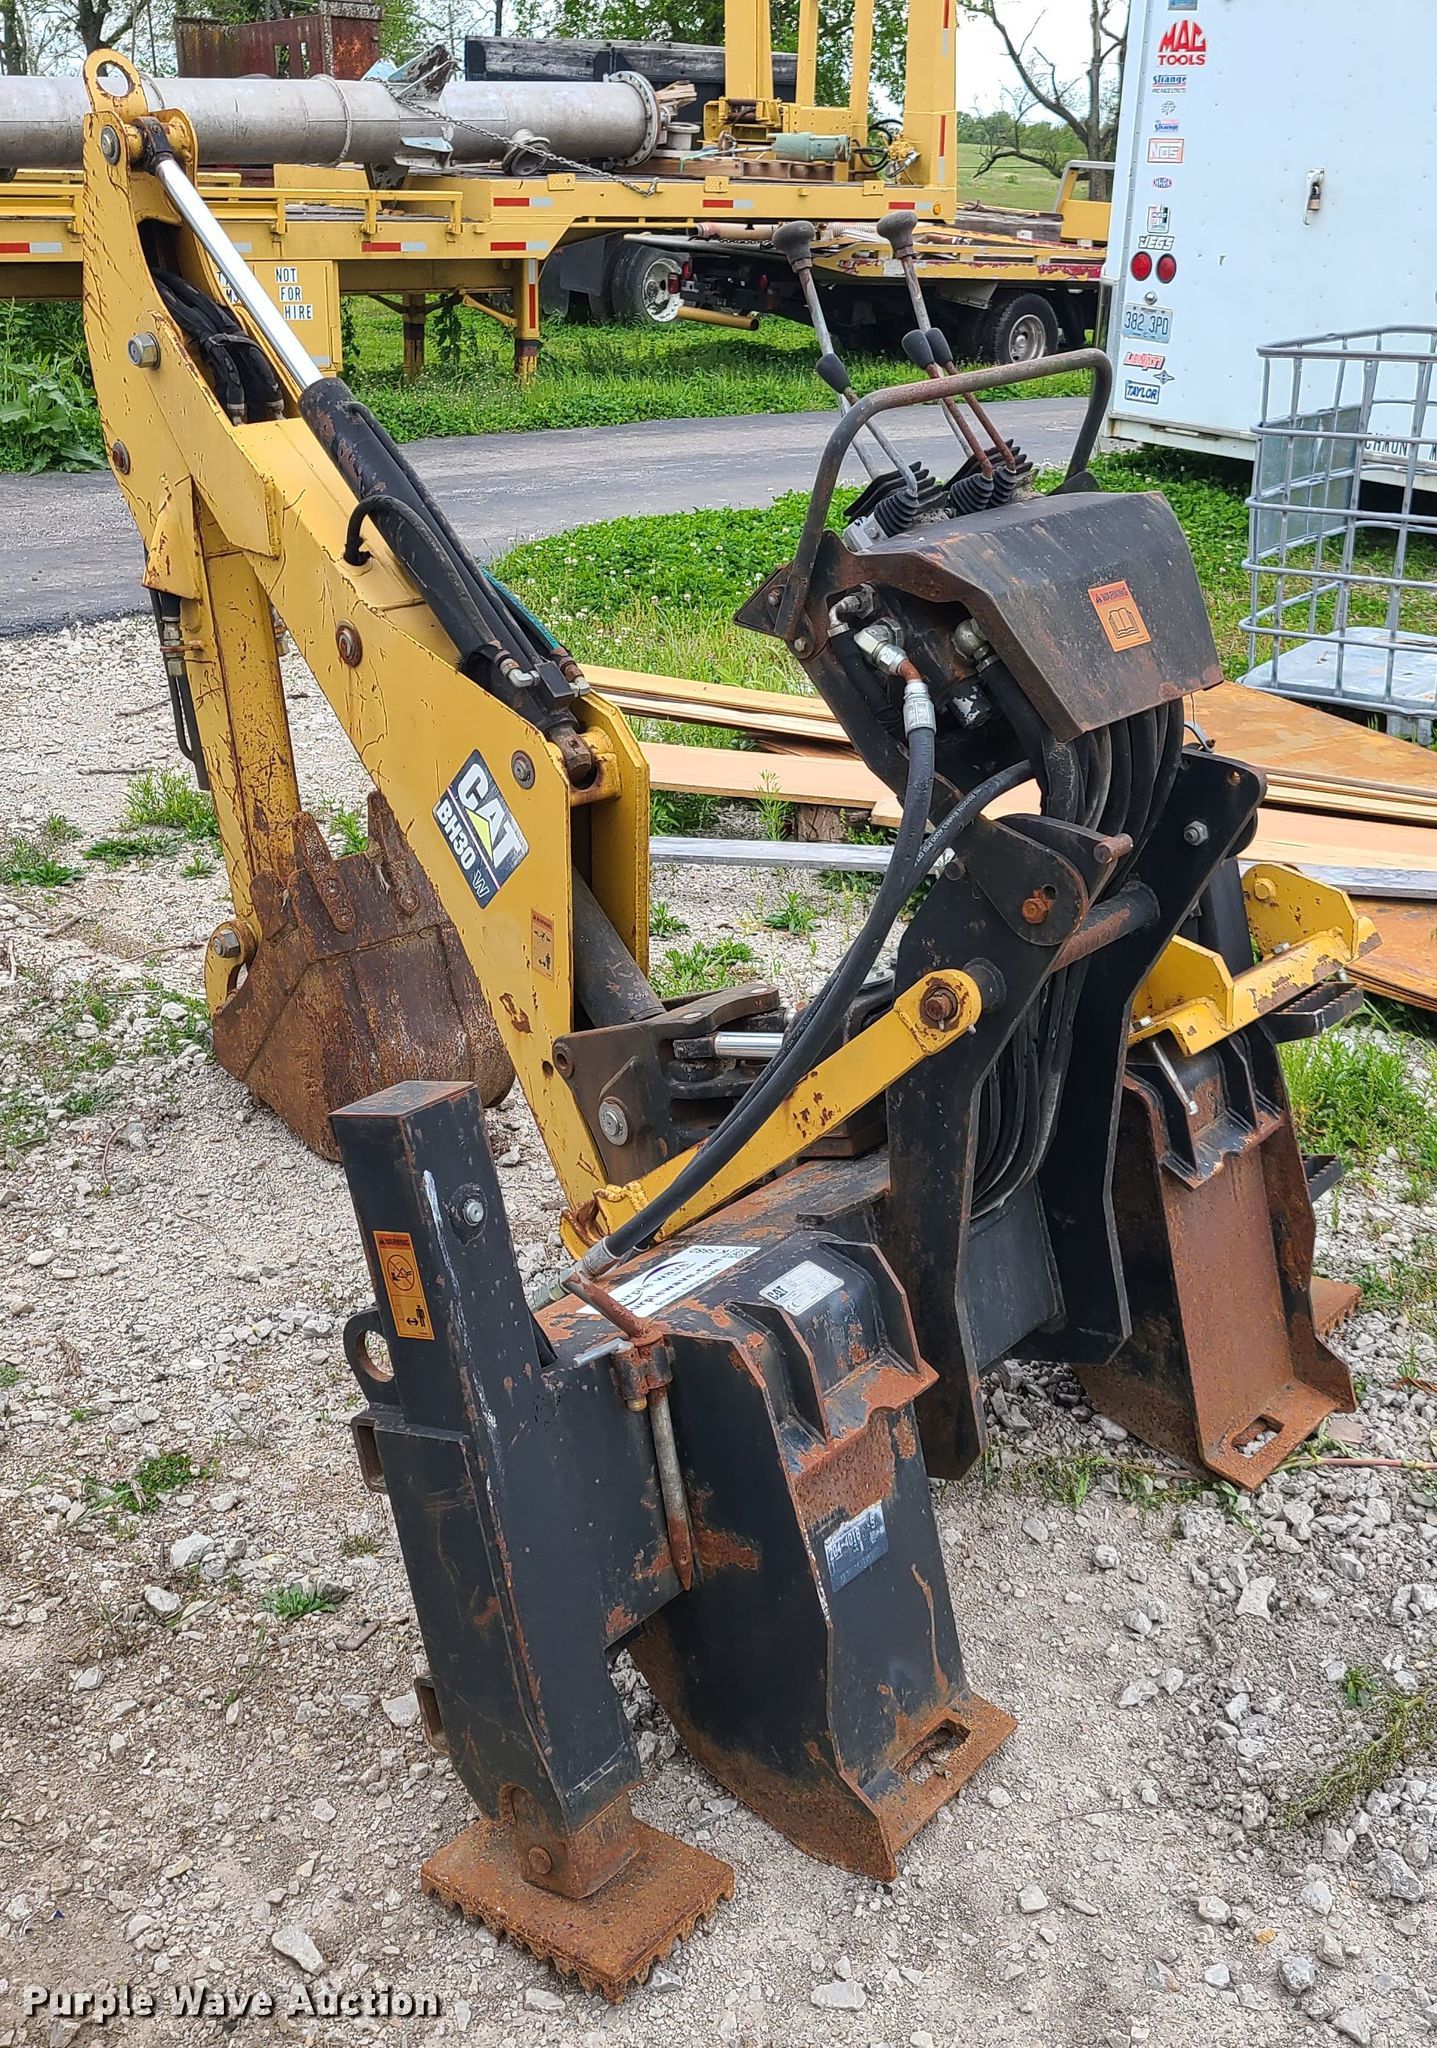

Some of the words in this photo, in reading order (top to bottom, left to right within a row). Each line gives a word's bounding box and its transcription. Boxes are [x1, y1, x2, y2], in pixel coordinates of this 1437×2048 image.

[1158, 20, 1206, 52] MAC
[1157, 54, 1206, 66] TOOLS
[1152, 74, 1187, 85] Strange
[1138, 235, 1175, 252] JEGS
[275, 268, 297, 283] NOT
[280, 286, 302, 301] FOR
[284, 305, 312, 320] HIRE
[1124, 311, 1145, 331] 382
[1127, 385, 1158, 401] TAYLOR
[457, 763, 522, 869] CAT
[436, 798, 476, 870] BH30
[618, 1282, 654, 1303] urple
[630, 1257, 723, 1312] urplewave.com
[766, 1285, 789, 1301] CAT
